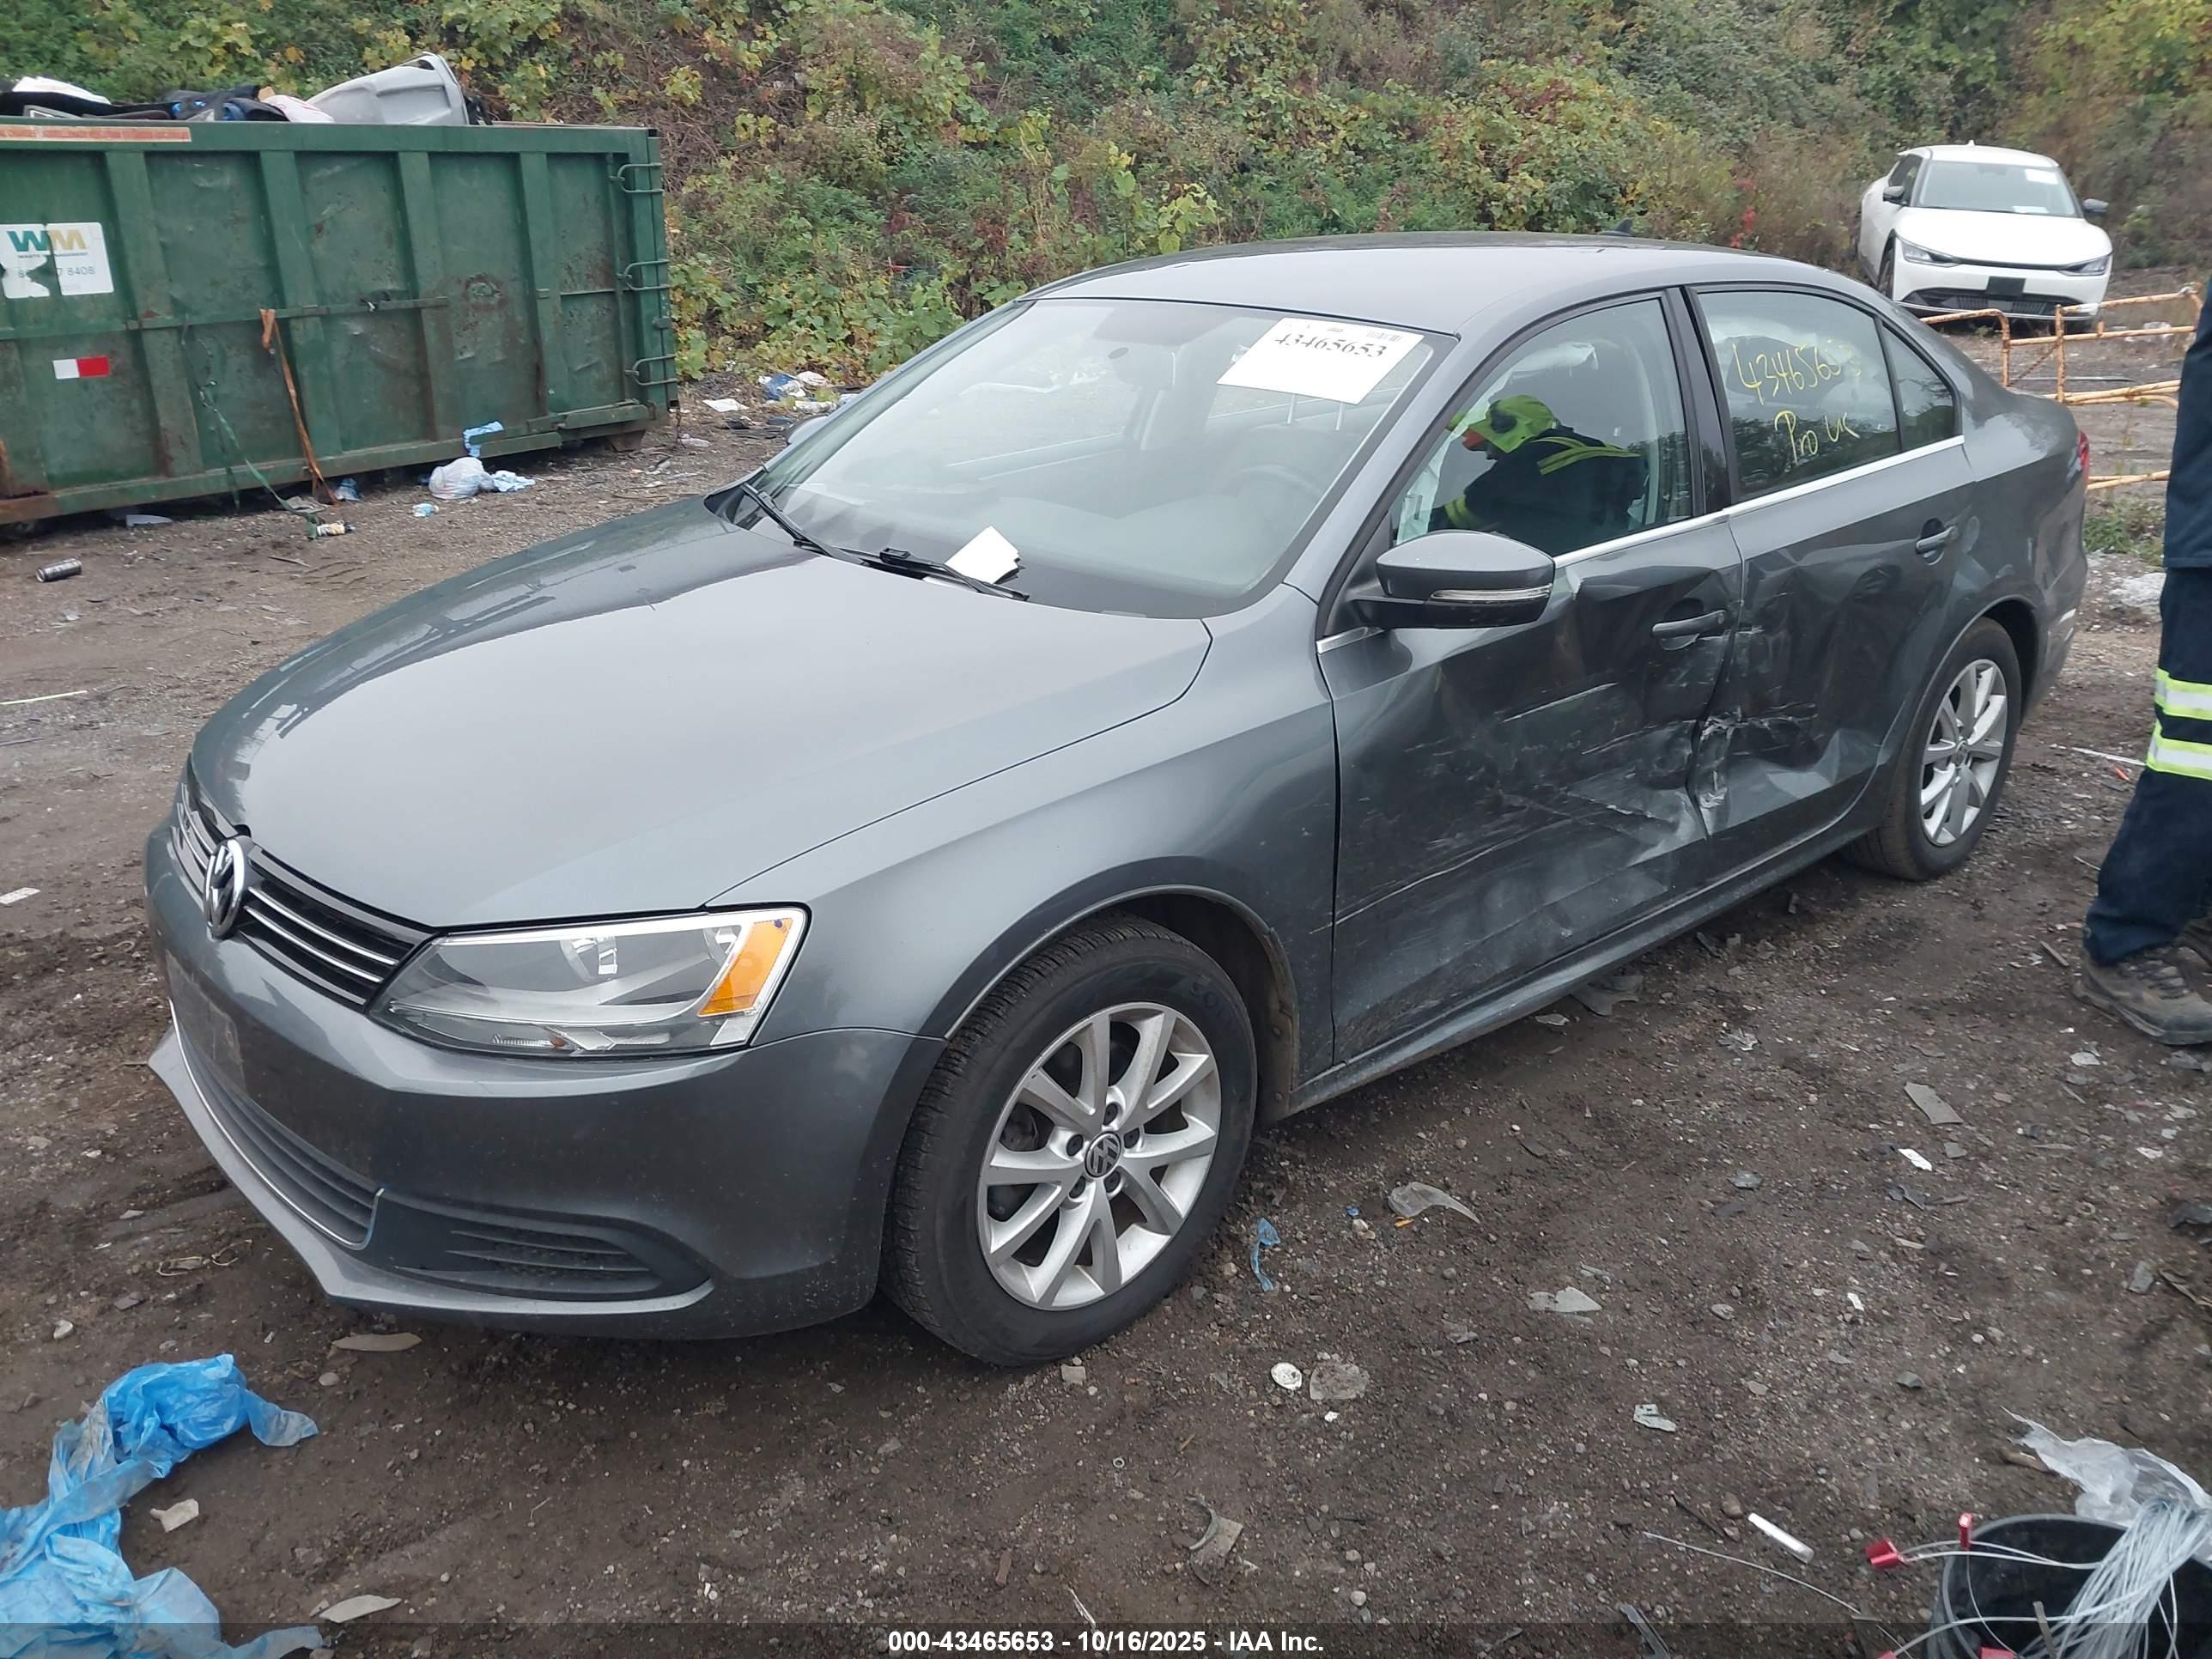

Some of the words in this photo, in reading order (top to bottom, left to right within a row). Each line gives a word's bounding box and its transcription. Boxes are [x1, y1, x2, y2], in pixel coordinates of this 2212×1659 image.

[6, 228, 87, 252] WM
[67, 266, 95, 276] 8408
[1275, 333, 1387, 357] 43465653
